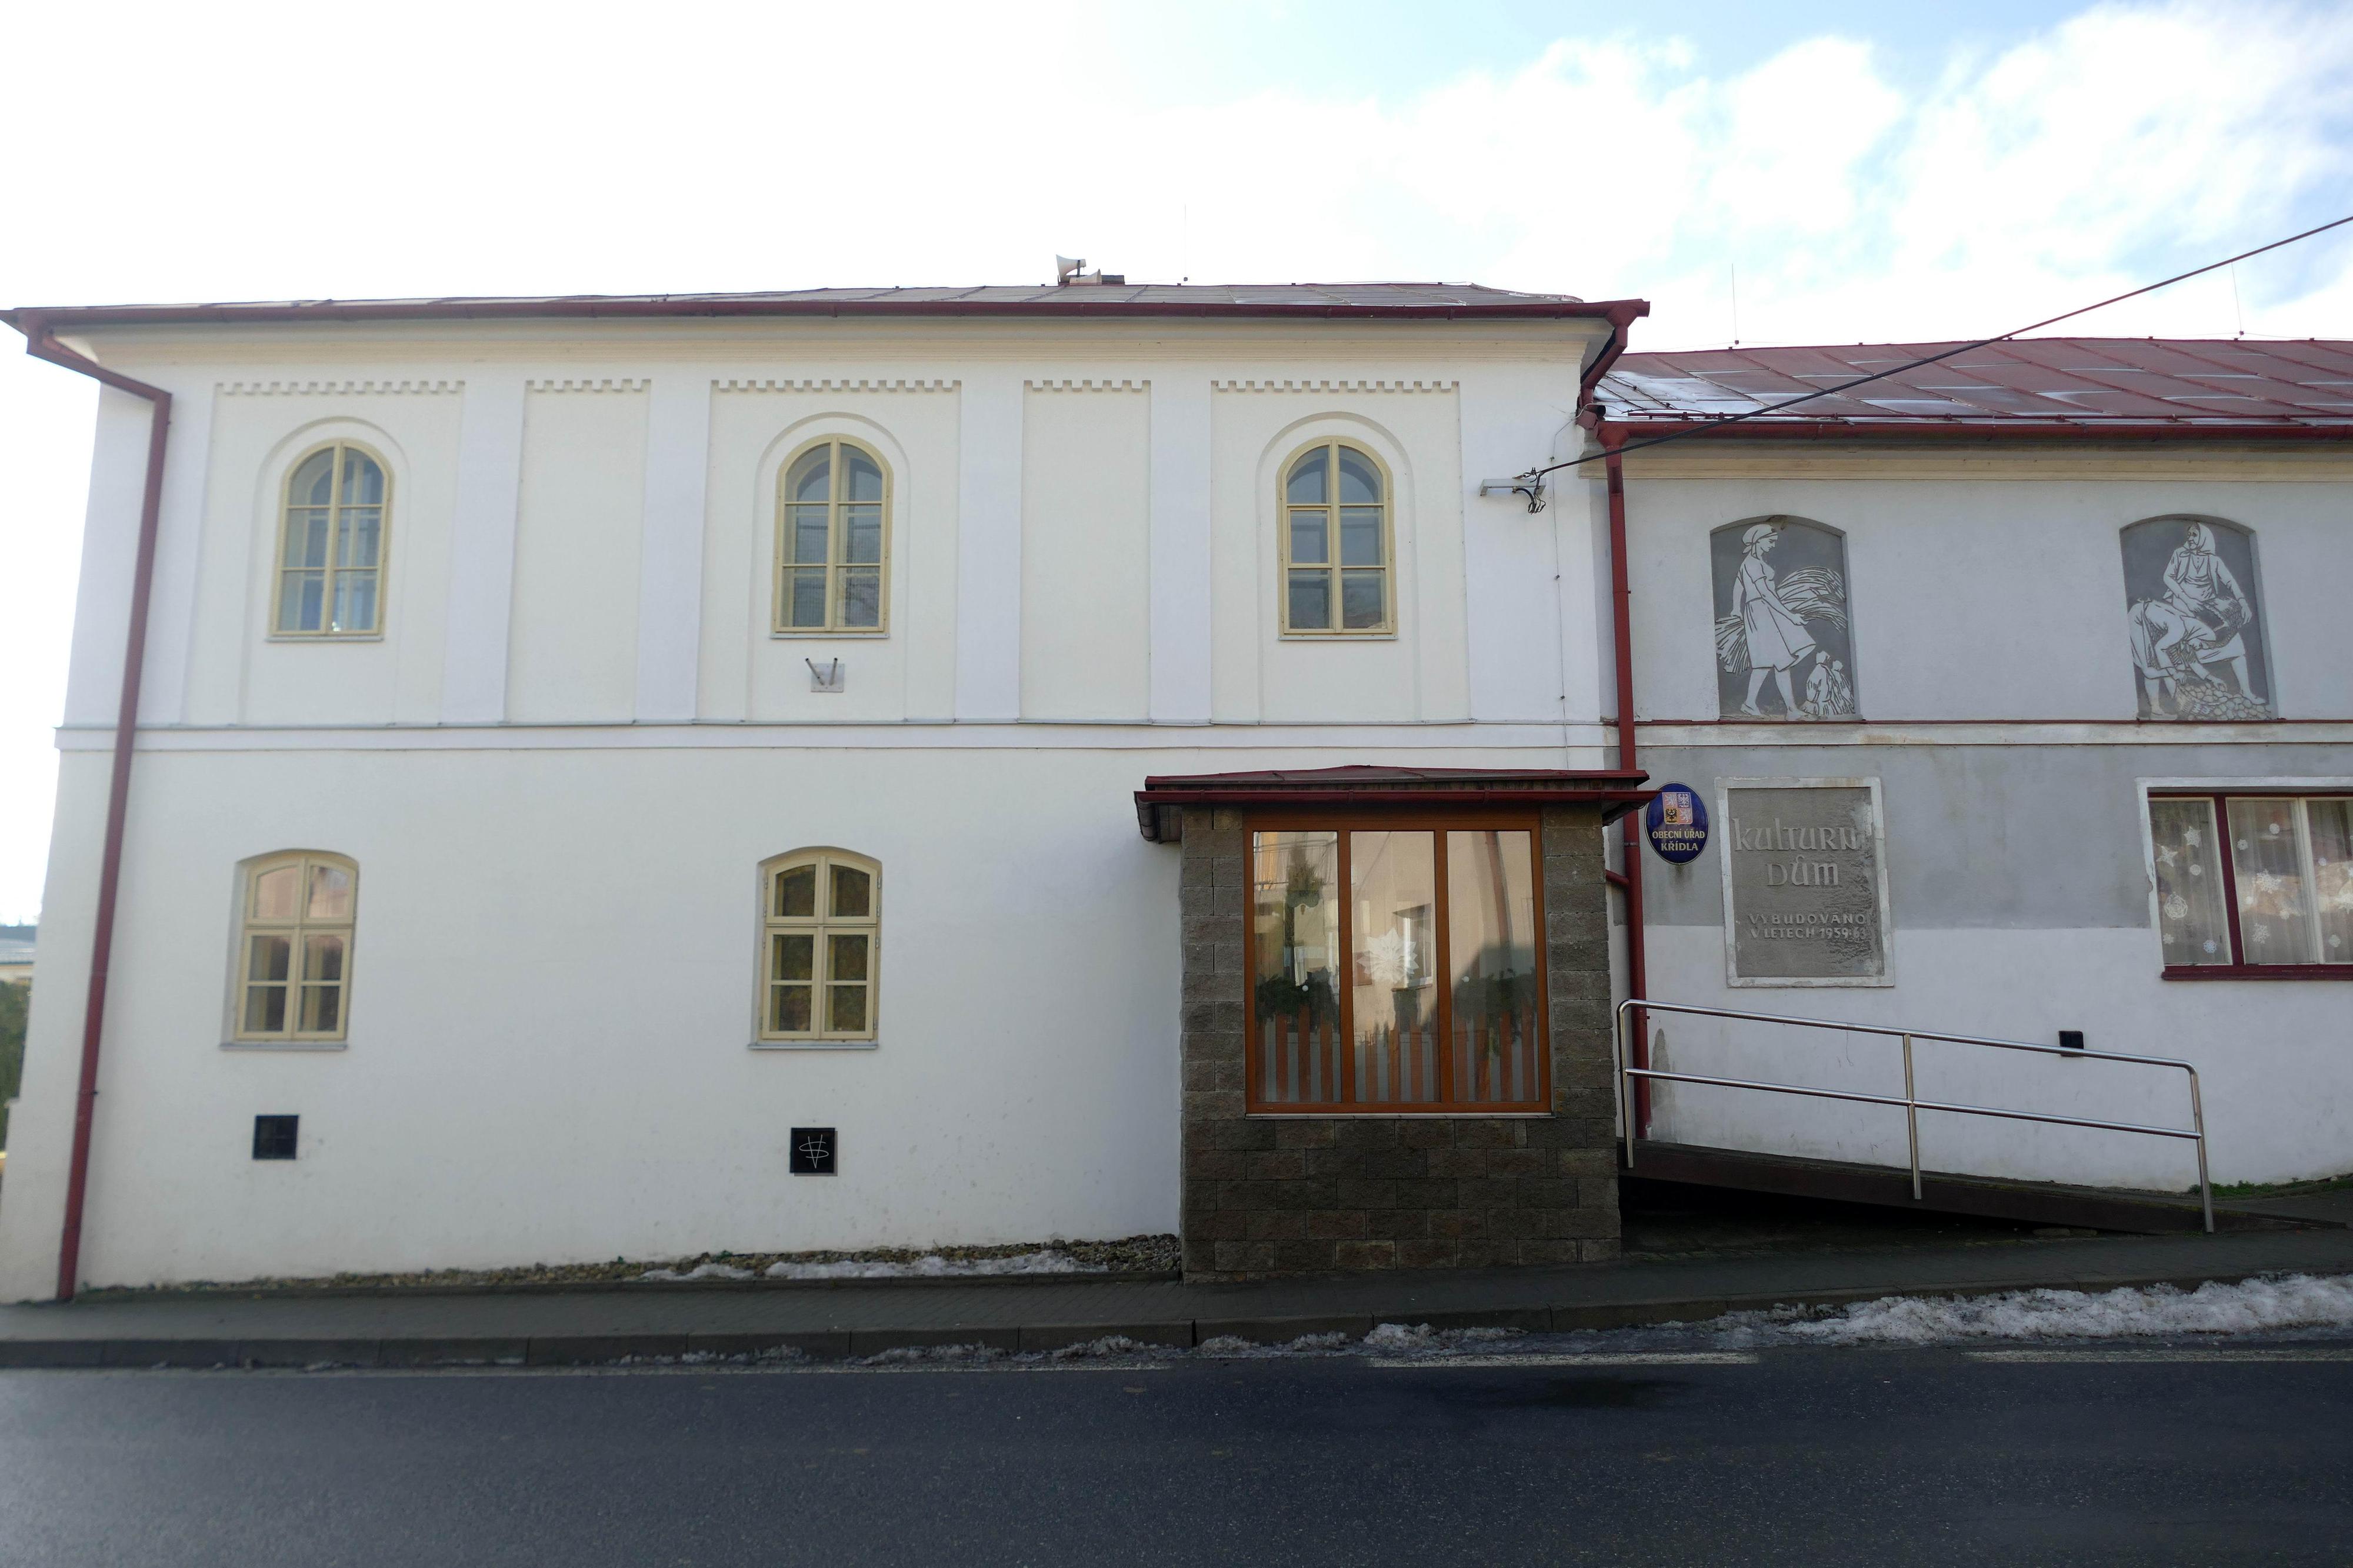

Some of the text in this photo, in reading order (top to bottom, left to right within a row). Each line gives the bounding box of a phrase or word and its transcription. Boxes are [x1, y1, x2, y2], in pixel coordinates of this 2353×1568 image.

[1652, 829, 1705, 839] OBECNÍ ÚŘAD
[1661, 840, 1698, 851] KŘÍDLA
[1749, 928, 1760, 939] V
[1764, 928, 1814, 939] LETECH
